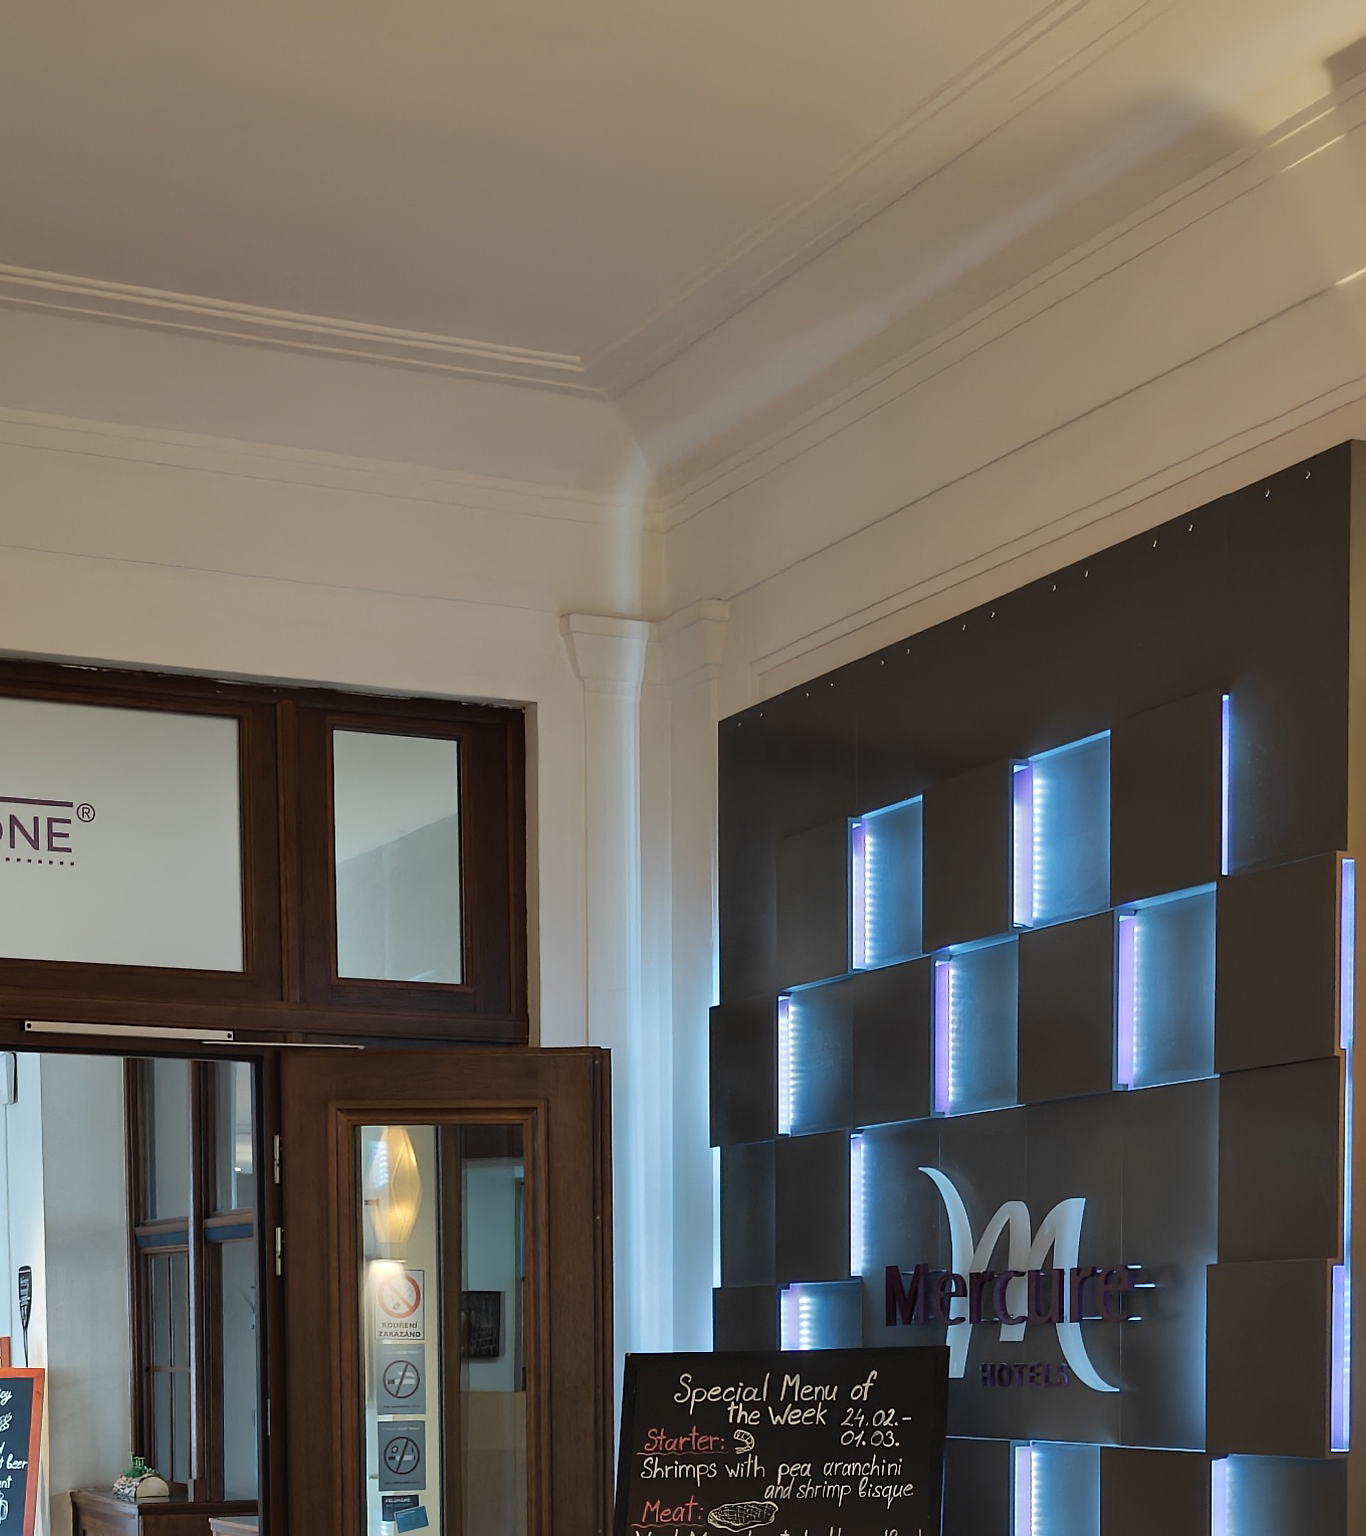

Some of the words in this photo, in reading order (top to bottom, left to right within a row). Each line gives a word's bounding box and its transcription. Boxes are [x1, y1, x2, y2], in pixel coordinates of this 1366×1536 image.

[885, 1263, 1137, 1327] Mercure
[979, 1362, 1071, 1389] HOTELS
[674, 1371, 770, 1416] Special
[780, 1373, 838, 1402] Menu
[850, 1370, 878, 1401] of
[727, 1401, 761, 1425] the
[768, 1402, 828, 1426] Week
[643, 1425, 726, 1452] Starter:
[840, 1430, 900, 1448] 01.03.
[6, 1454, 29, 1470] beer
[640, 1456, 718, 1488] Shrimps
[725, 1453, 766, 1479] with
[777, 1461, 812, 1487] pea
[822, 1454, 903, 1478] aranchini
[764, 1479, 794, 1500] and
[796, 1478, 852, 1508] shrimp
[858, 1476, 915, 1510] bisque
[641, 1496, 705, 1524] Meat:
